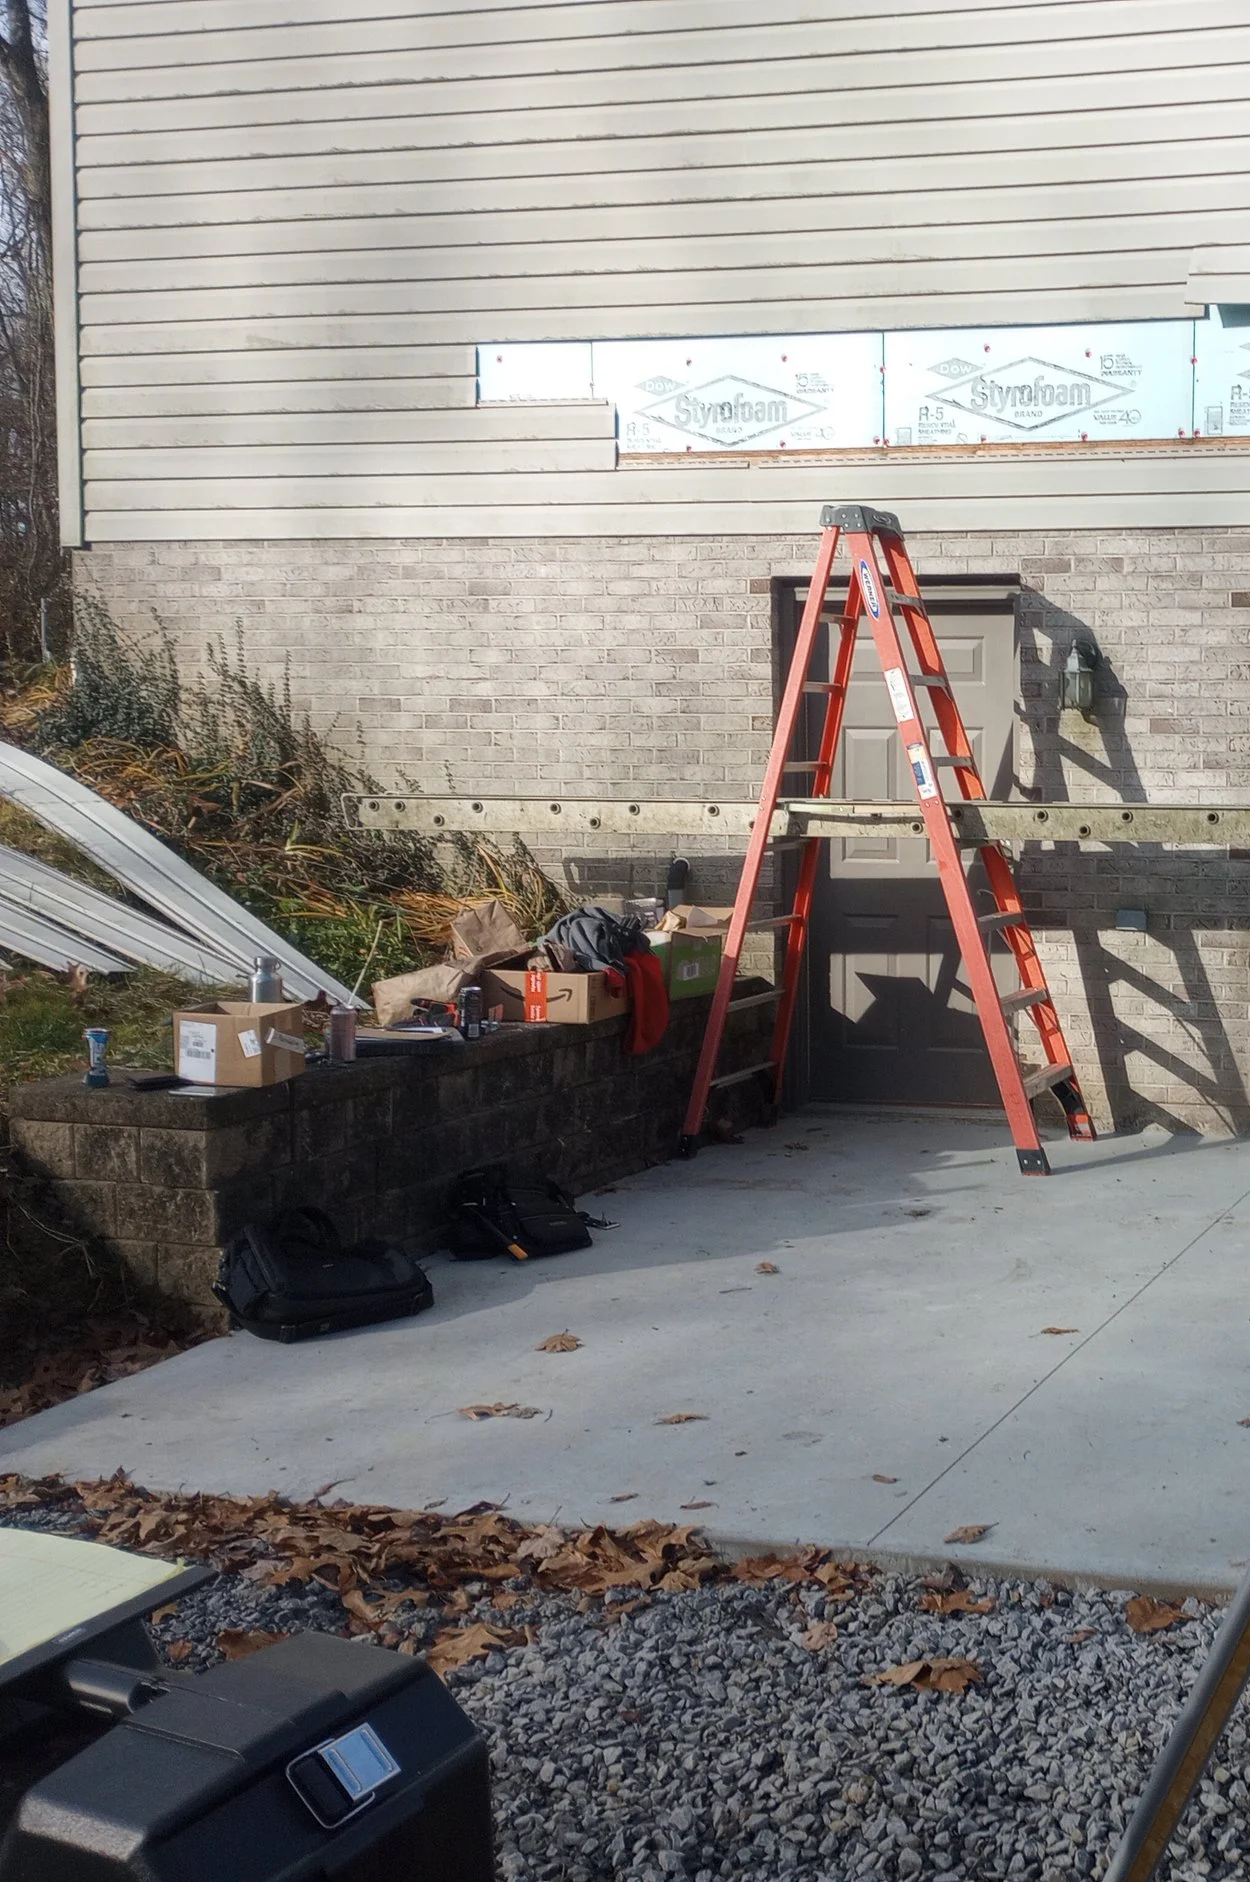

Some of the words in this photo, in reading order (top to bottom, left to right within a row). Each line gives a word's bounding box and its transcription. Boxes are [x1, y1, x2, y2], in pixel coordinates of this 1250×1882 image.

[940, 363, 971, 374] DOW
[1100, 354, 1114, 370] 15
[1100, 369, 1143, 377] WARRANTY
[970, 375, 1091, 413] Styrofoam
[674, 392, 787, 429] Styrofoam
[918, 406, 944, 421] R-5
[1014, 410, 1043, 418] BRAND
